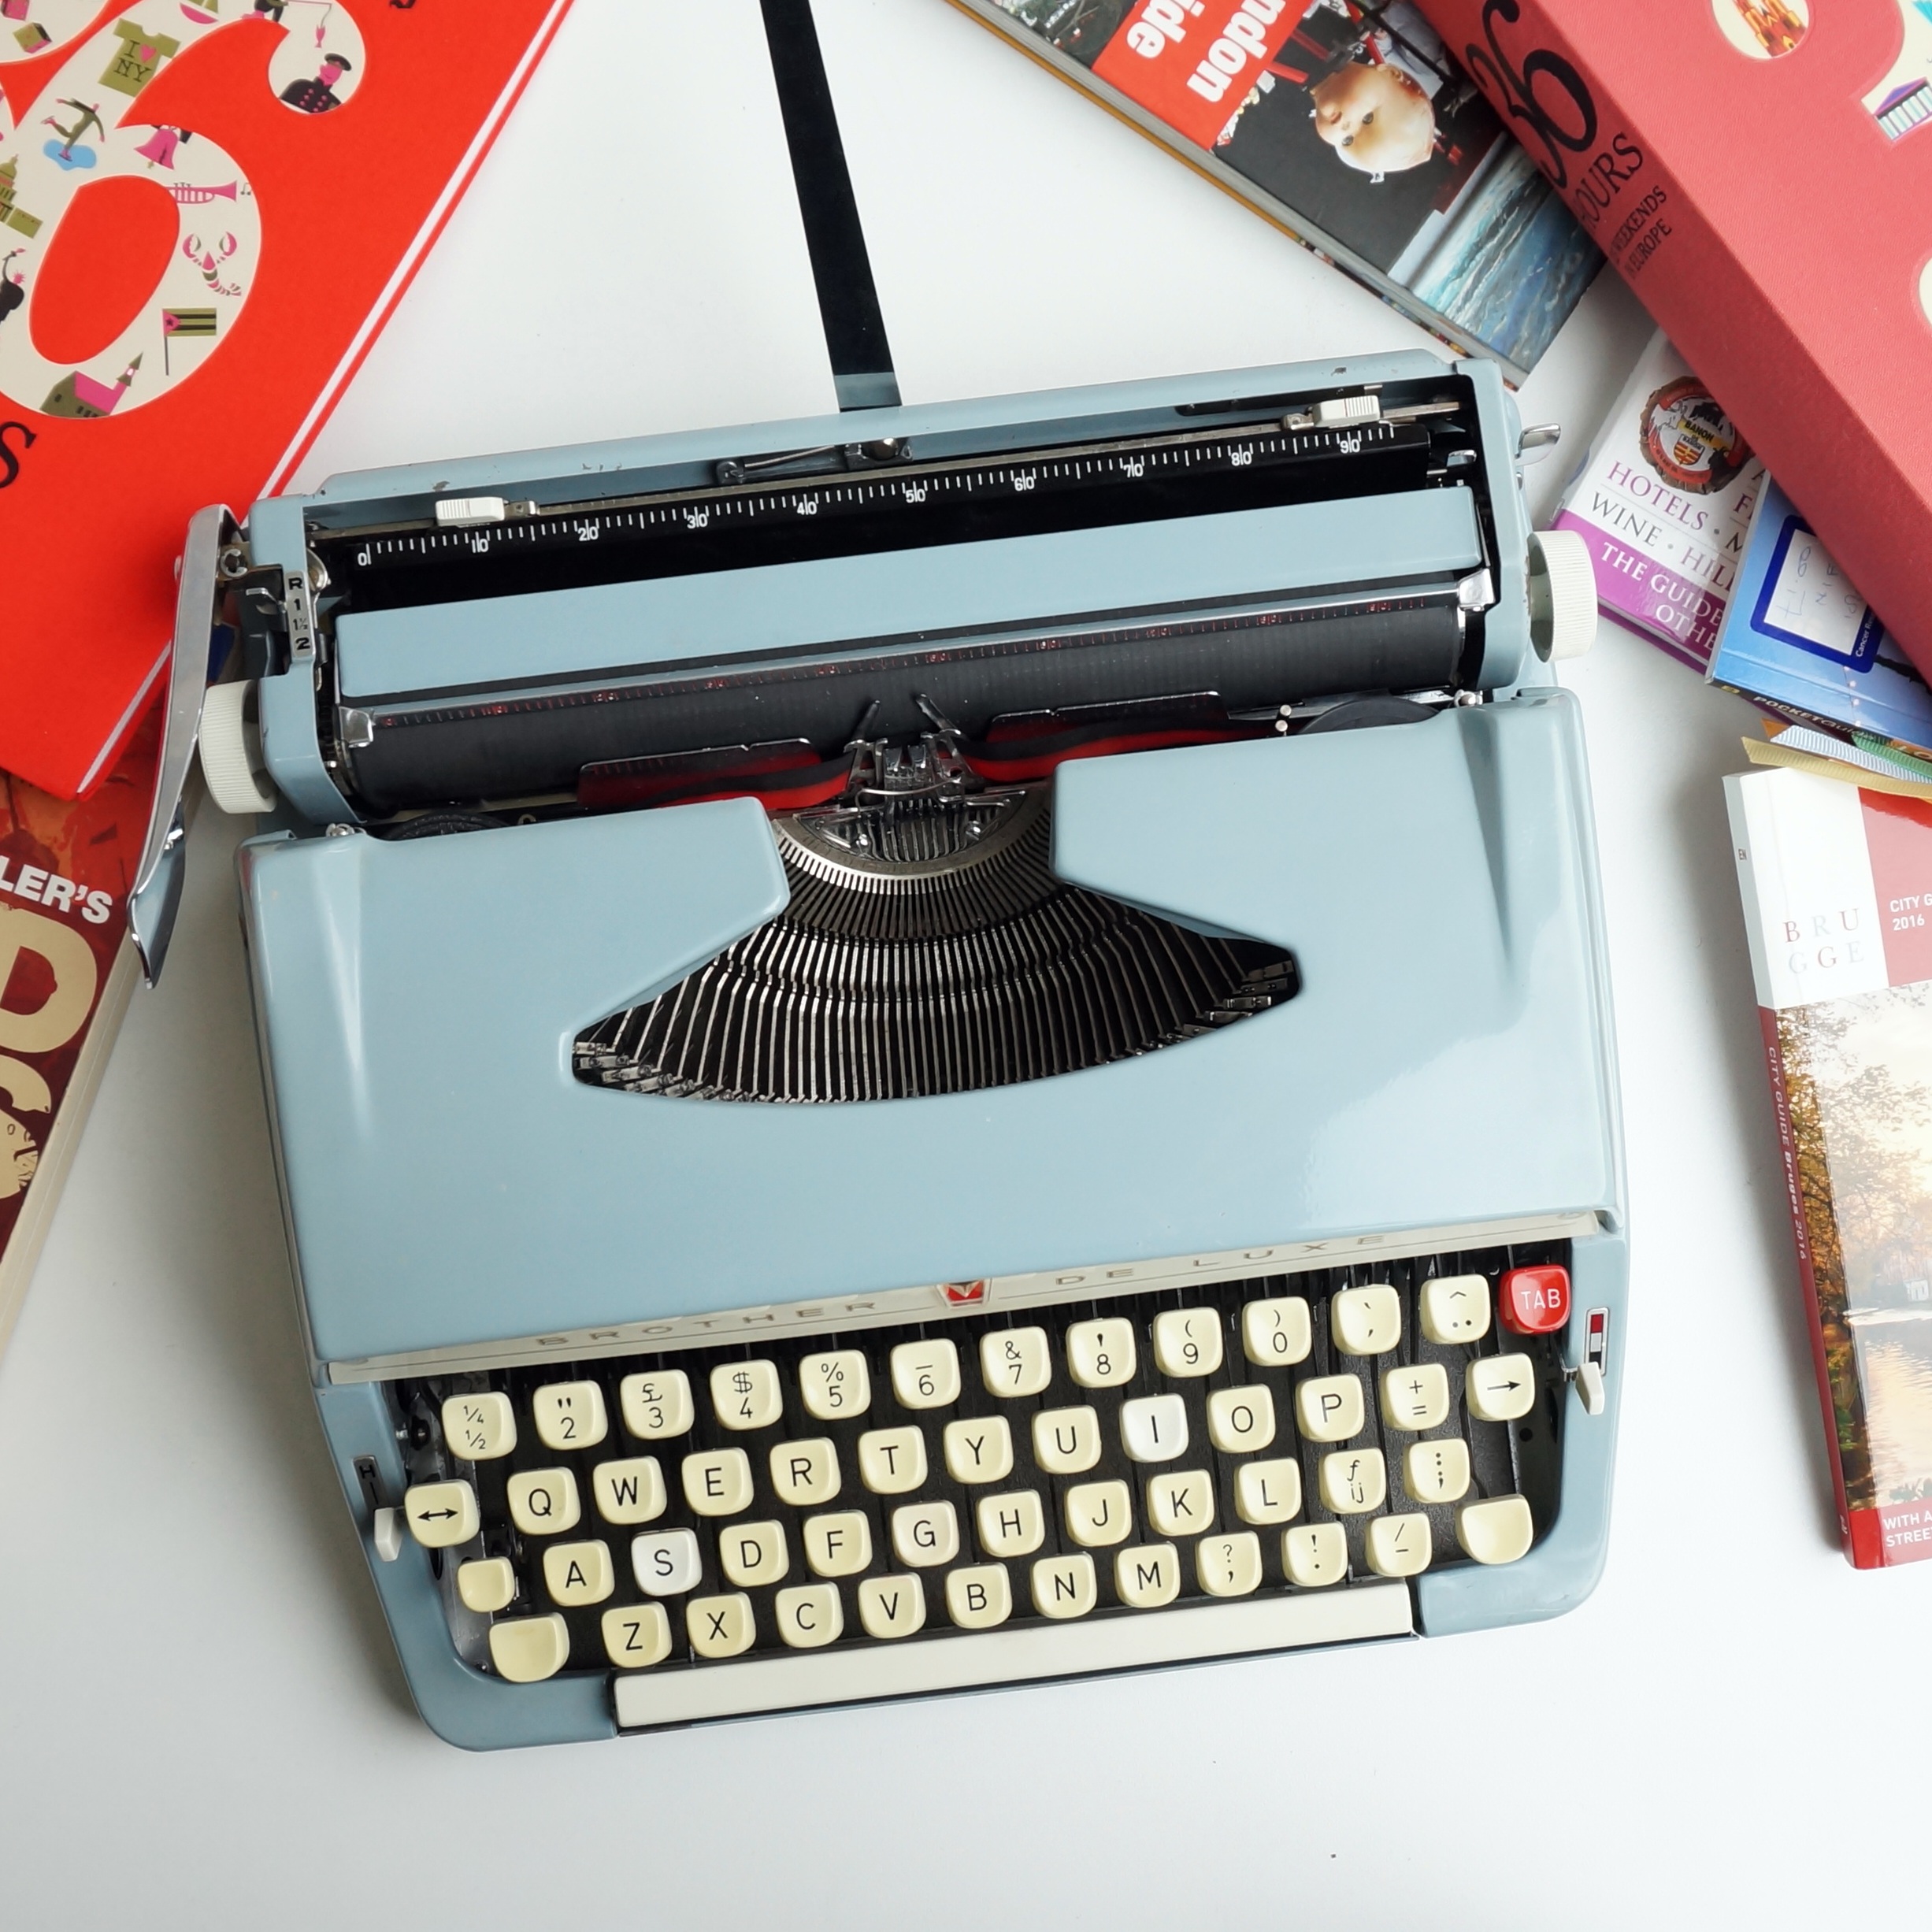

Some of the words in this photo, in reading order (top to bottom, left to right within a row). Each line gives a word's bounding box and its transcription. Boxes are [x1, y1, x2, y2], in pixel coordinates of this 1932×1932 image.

[113, 57, 151, 83] NY
[1629, 217, 1672, 273] EUROPE
[1685, 421, 1715, 443] BANON
[358, 552, 367, 566] 0
[472, 538, 488, 553] 10
[578, 525, 599, 541] 20
[687, 512, 707, 528] 30
[796, 501, 817, 515] 40
[906, 488, 925, 503] 50
[1014, 477, 1034, 491] 60
[1124, 463, 1144, 478] 70
[1231, 452, 1252, 466] 80
[1340, 439, 1360, 454] 90
[1592, 491, 1663, 548] WINE
[1607, 461, 1708, 531] HOTELS
[288, 577, 303, 590] R
[294, 599, 301, 610] 1
[1601, 542, 1648, 581] THE
[1651, 574, 1723, 626] GUIDE
[295, 637, 310, 650] 2
[1856, 630, 1871, 658] Cancer
[1889, 896, 1919, 912] CITY
[1893, 914, 1925, 931] 2016
[1768, 1047, 1781, 1086] CITY
[1775, 1091, 1789, 1147] GUIDE
[1784, 1151, 1799, 1214] Bruges
[1795, 1220, 1807, 1260] 2016
[537, 1301, 876, 1345] BROTHER
[1055, 1268, 1135, 1285] DE
[1193, 1235, 1384, 1267] LUXE
[643, 1383, 662, 1403] £
[732, 1372, 752, 1393] $
[821, 1363, 844, 1382] %
[1005, 1341, 1022, 1359] &
[1521, 1288, 1562, 1311] TAB
[561, 1417, 576, 1439] 2
[649, 1407, 663, 1428] 3
[740, 1397, 752, 1418] 4
[829, 1385, 842, 1407] 5
[919, 1374, 934, 1396] 6
[1009, 1364, 1022, 1384] 7
[1097, 1354, 1111, 1374] 8
[1183, 1343, 1198, 1364] 9
[1273, 1332, 1287, 1353] 0
[529, 1489, 551, 1516] Q
[612, 1477, 637, 1506] W
[706, 1467, 724, 1496] E
[791, 1458, 812, 1486] R
[881, 1446, 898, 1474] T
[966, 1437, 984, 1465] Y
[1056, 1426, 1076, 1454] U
[1151, 1416, 1158, 1443] I
[1232, 1406, 1253, 1433] O
[1322, 1394, 1341, 1422] P
[566, 1561, 586, 1588] A
[655, 1549, 673, 1576] S
[741, 1541, 762, 1568] D
[827, 1530, 843, 1559] F
[914, 1520, 936, 1547] G
[1000, 1509, 1022, 1537] H
[1092, 1500, 1107, 1526] J
[1171, 1489, 1192, 1517] K
[1262, 1479, 1277, 1506] L
[1883, 1512, 1919, 1530] WITH
[1886, 1526, 1932, 1547] STREE
[623, 1622, 643, 1650] Z
[707, 1611, 728, 1640] X
[796, 1603, 815, 1630] C
[880, 1593, 898, 1620] V
[967, 1584, 987, 1611] B
[1055, 1573, 1075, 1600] N
[1137, 1562, 1161, 1589] M
